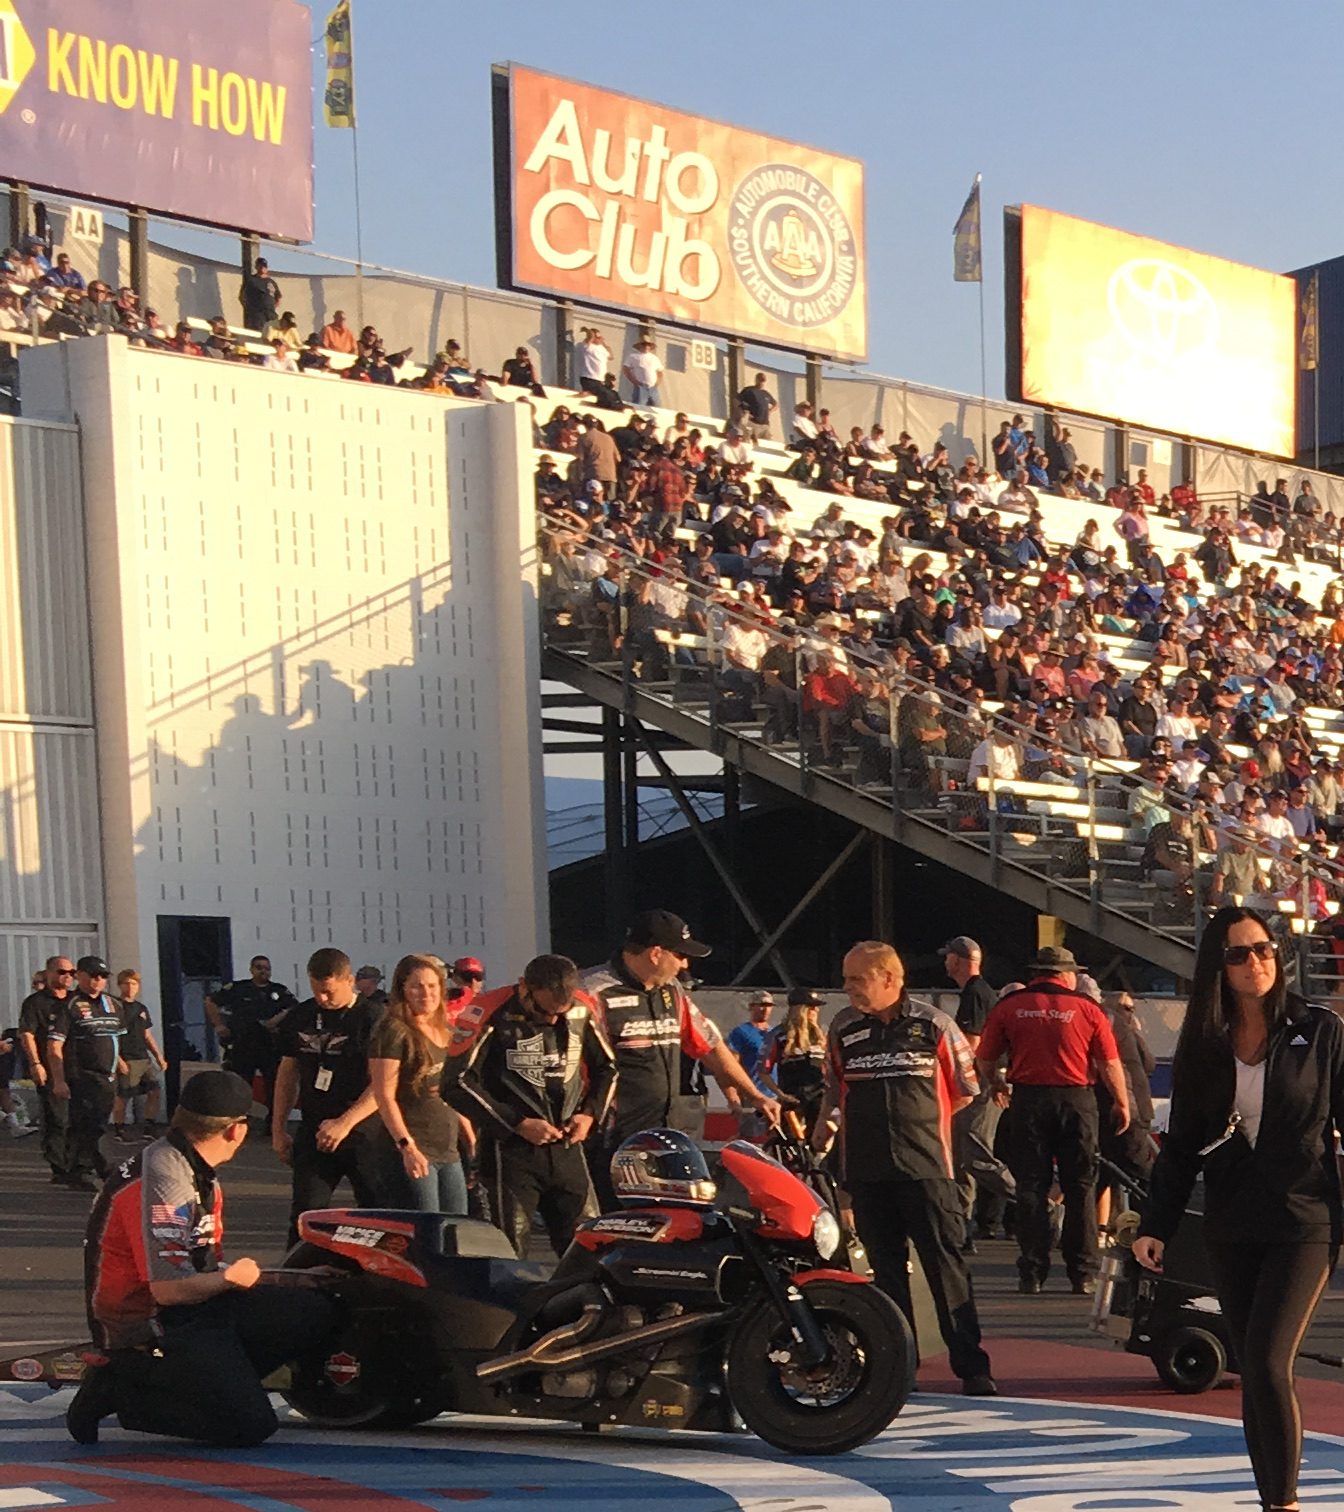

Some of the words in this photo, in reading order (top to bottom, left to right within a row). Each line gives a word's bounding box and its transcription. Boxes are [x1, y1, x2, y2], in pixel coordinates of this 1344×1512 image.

[48, 28, 178, 119] KNOW
[191, 63, 287, 145] HOW
[524, 99, 720, 214] Auto
[75, 210, 99, 237] AA
[734, 168, 818, 214] AUTOMOBILE
[819, 194, 853, 243] CLUB
[530, 188, 722, 301] Club
[763, 219, 823, 264] AAA
[730, 222, 792, 320] SOUTHERN
[792, 254, 855, 324] CALIFORNIA
[693, 344, 714, 365] BB
[1016, 1009, 1047, 1020] Event
[1048, 1008, 1076, 1023] Staff
[846, 1057, 935, 1070] DAVIDSON
[849, 1051, 918, 1064] HARLEY
